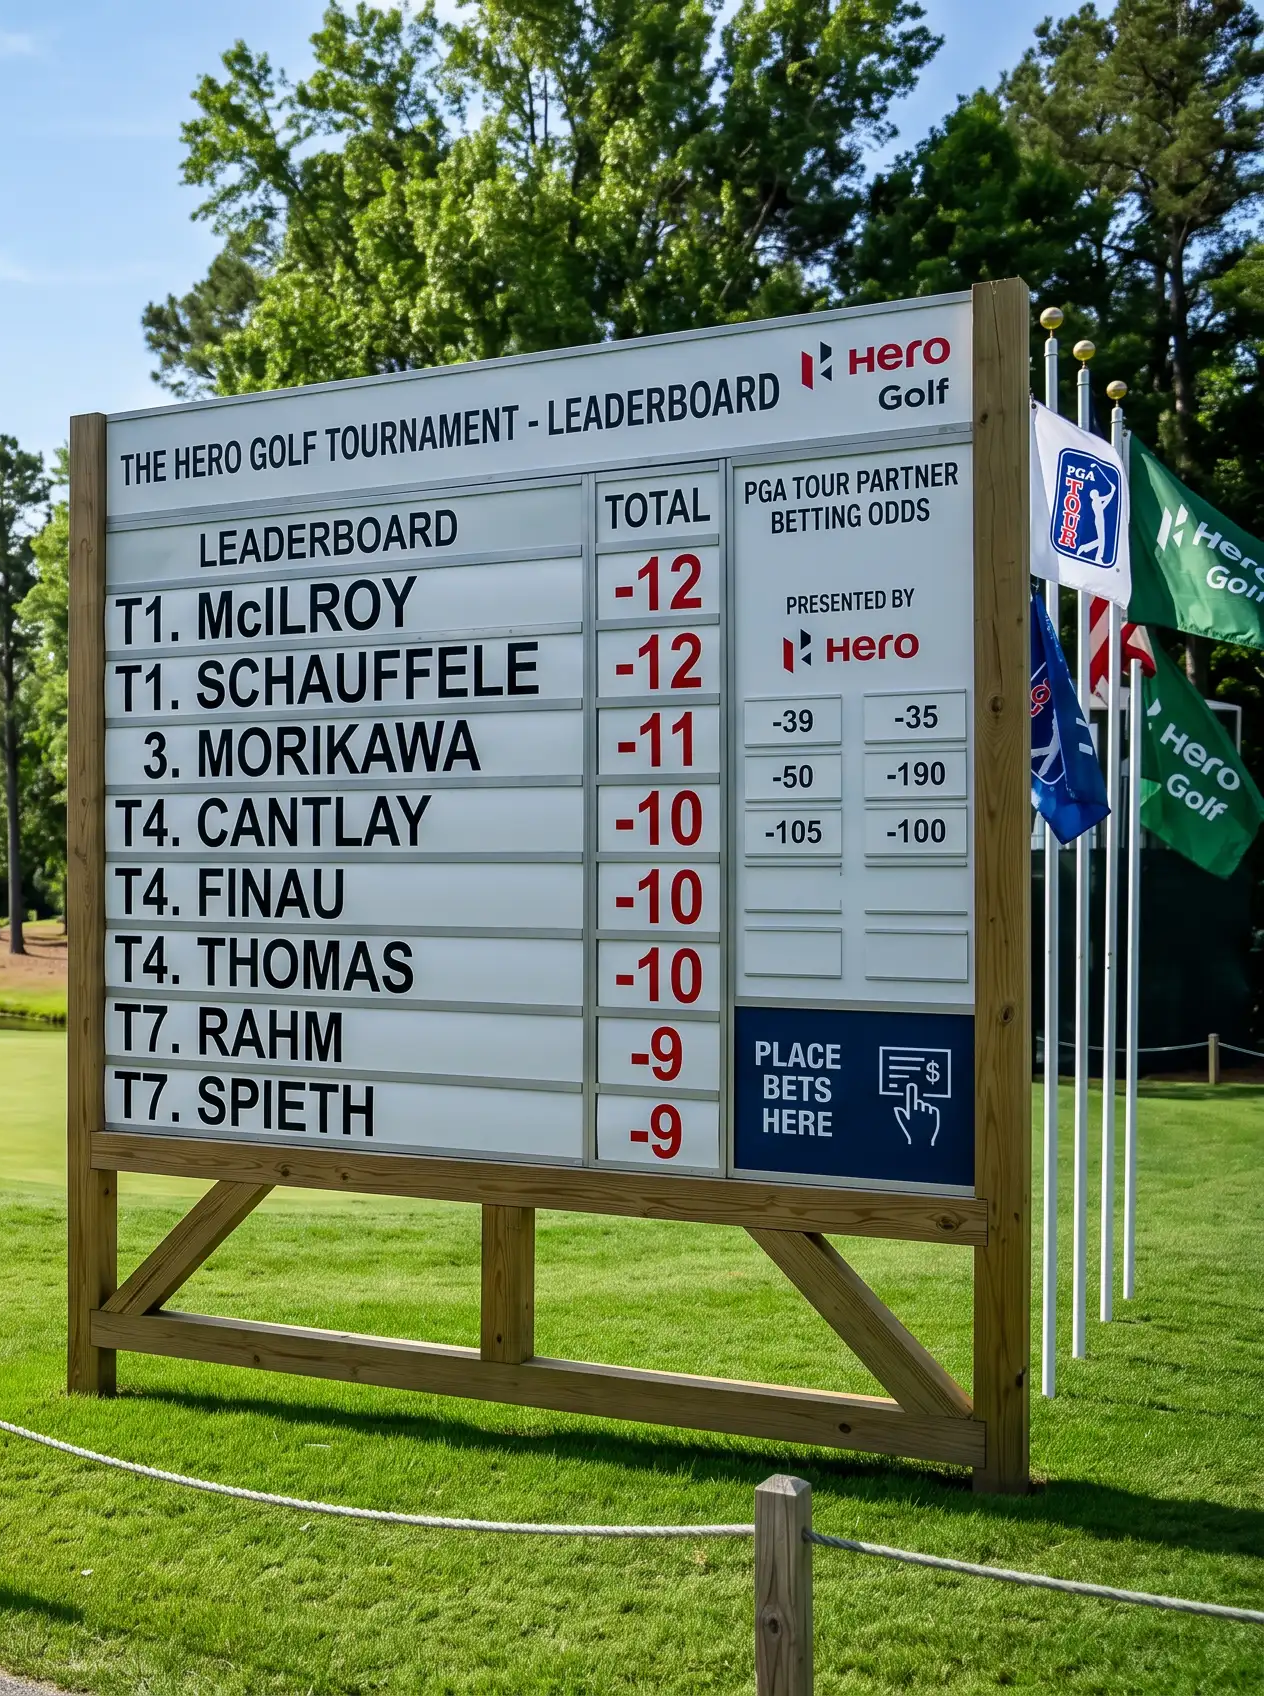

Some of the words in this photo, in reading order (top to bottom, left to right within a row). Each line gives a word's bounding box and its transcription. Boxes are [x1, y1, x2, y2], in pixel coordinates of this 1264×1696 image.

[849, 337, 951, 375] Hero
[878, 377, 950, 411] Golf
[120, 449, 167, 486] THE
[174, 440, 242, 480] HERO
[249, 430, 318, 471] GOLF
[324, 404, 520, 462] TOURNAMENT
[548, 372, 780, 436] LEADERBOARD
[744, 478, 788, 505] PGA
[792, 472, 850, 500] TOUR
[856, 461, 958, 494] PARTNER
[1066, 464, 1096, 482] PGA
[604, 487, 711, 530] TOTAL
[771, 503, 862, 535] BETTING
[868, 497, 930, 526] ODDS
[1058, 477, 1084, 548] TOUR
[199, 508, 459, 568] LEADERBOARD
[615, 553, 702, 611] -12
[785, 589, 887, 615] PRESENTED
[891, 587, 915, 609] BY
[114, 594, 180, 646] T1.
[197, 575, 418, 640] McILROY
[615, 632, 703, 690] -12
[826, 632, 920, 663] Hero
[114, 663, 180, 713] T1.
[196, 641, 540, 711] SCHAUFFELE
[617, 711, 693, 767] -11
[772, 709, 814, 733] -39
[894, 704, 938, 729] -35
[143, 731, 180, 780] 3.
[197, 719, 482, 778] MORIKAWA
[886, 761, 946, 786] -190
[1159, 722, 1241, 791] Hero
[772, 764, 814, 789] -50
[1166, 773, 1229, 821] Golf
[114, 798, 181, 848] T4.
[196, 794, 433, 848] CANTLAY
[615, 789, 703, 847] -10
[765, 819, 822, 844] -105
[886, 818, 946, 844] -100
[114, 867, 180, 916] T4.
[198, 867, 344, 920] FINAU
[615, 868, 703, 925] -10
[114, 934, 180, 985] T4.
[197, 936, 415, 994] THOMAS
[615, 947, 703, 1004] -10
[114, 1002, 180, 1055] T7.
[197, 1006, 344, 1064] RAHM
[631, 1025, 683, 1081] -9
[755, 1040, 842, 1070] PLACE
[114, 1070, 180, 1123] T7.
[196, 1074, 375, 1137] SPIETH
[763, 1074, 832, 1103] BETS
[629, 1103, 682, 1160] -9
[763, 1107, 833, 1137] HERE
